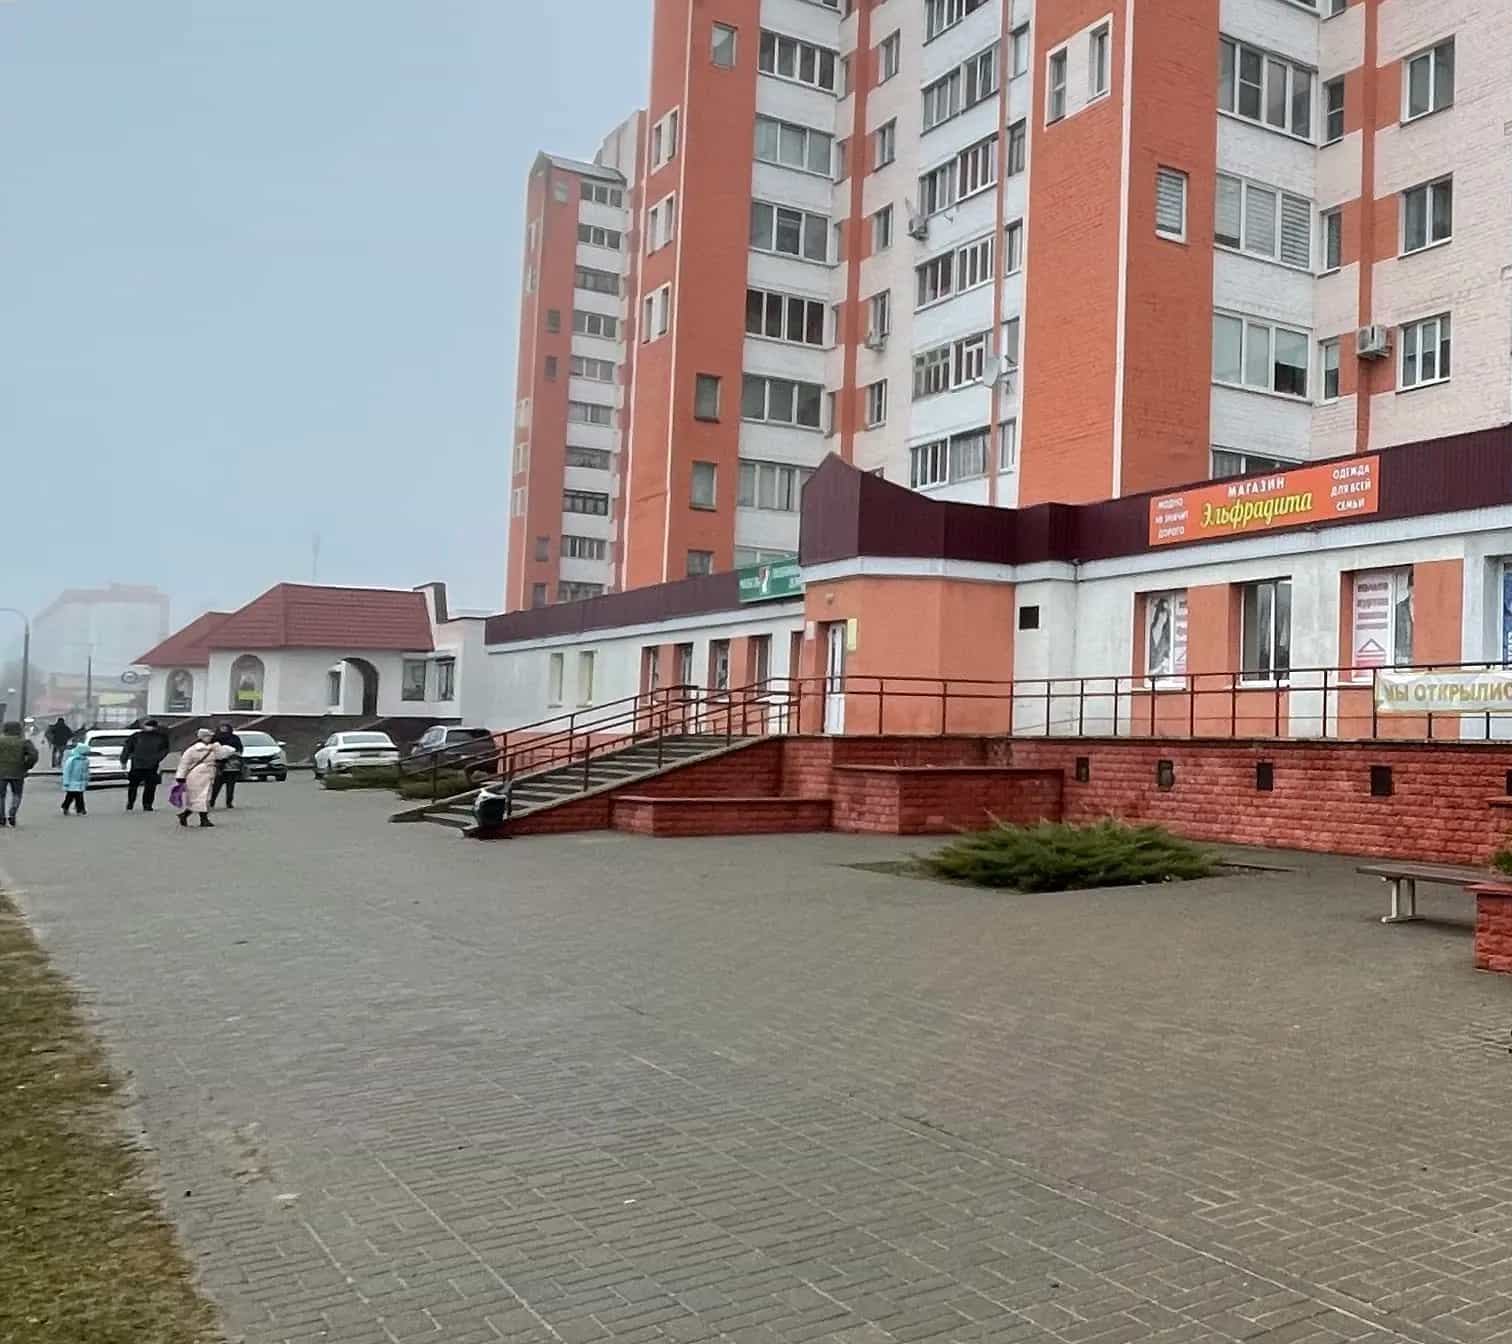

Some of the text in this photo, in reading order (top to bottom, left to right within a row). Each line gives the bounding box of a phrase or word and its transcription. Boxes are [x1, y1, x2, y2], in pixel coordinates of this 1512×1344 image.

[1332, 464, 1370, 479] ОДЕЖДА
[1228, 477, 1286, 497] МАГАЗИН
[1330, 479, 1371, 497] ДЛЯ ВСЕЙ
[1201, 491, 1312, 528] Эльфрадита
[1336, 498, 1365, 512] СЕМЬИ
